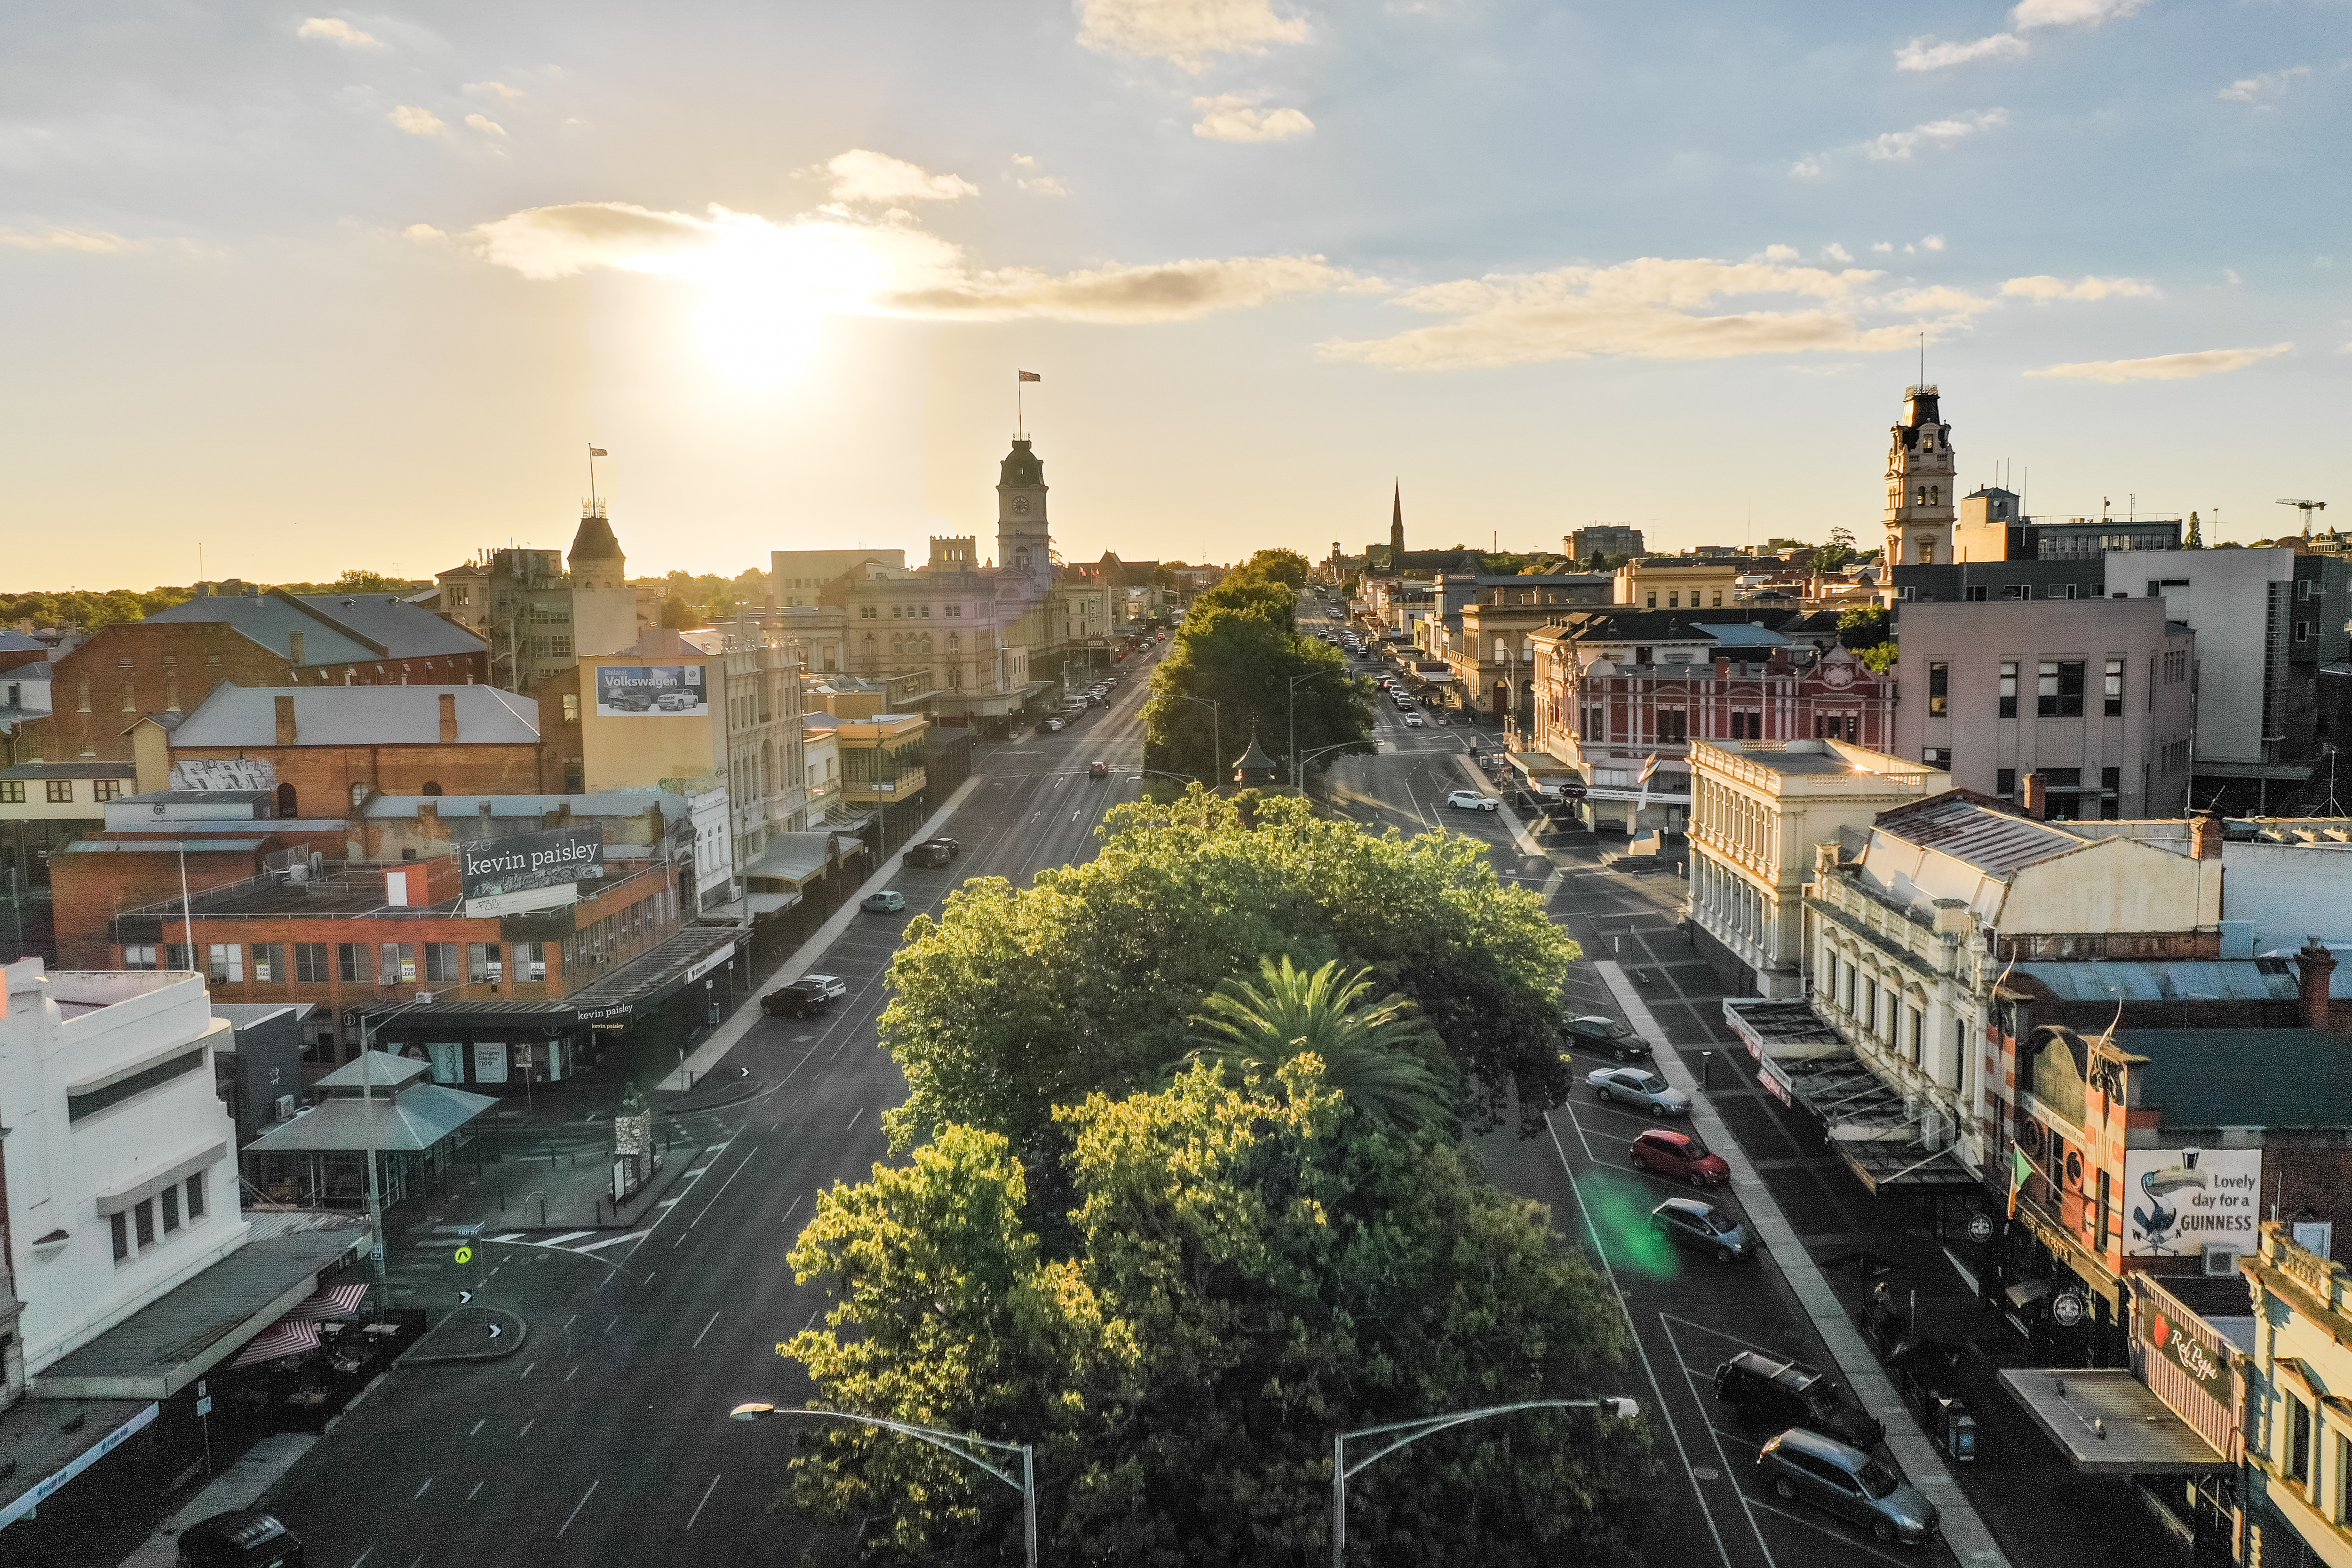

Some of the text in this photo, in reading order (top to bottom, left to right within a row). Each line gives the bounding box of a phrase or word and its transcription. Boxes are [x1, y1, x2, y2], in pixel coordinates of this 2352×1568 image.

[605, 676, 677, 689] Volkswagen
[467, 839, 598, 876] kevin paisley
[577, 1003, 633, 1020] kevin paisley
[2214, 1173, 2256, 1191] Lovely
[2192, 1193, 2249, 1209] day for a
[2180, 1214, 2252, 1231] GUINNESS
[2171, 1329, 2196, 1367] Red
[2192, 1345, 2217, 1381] Peppa
